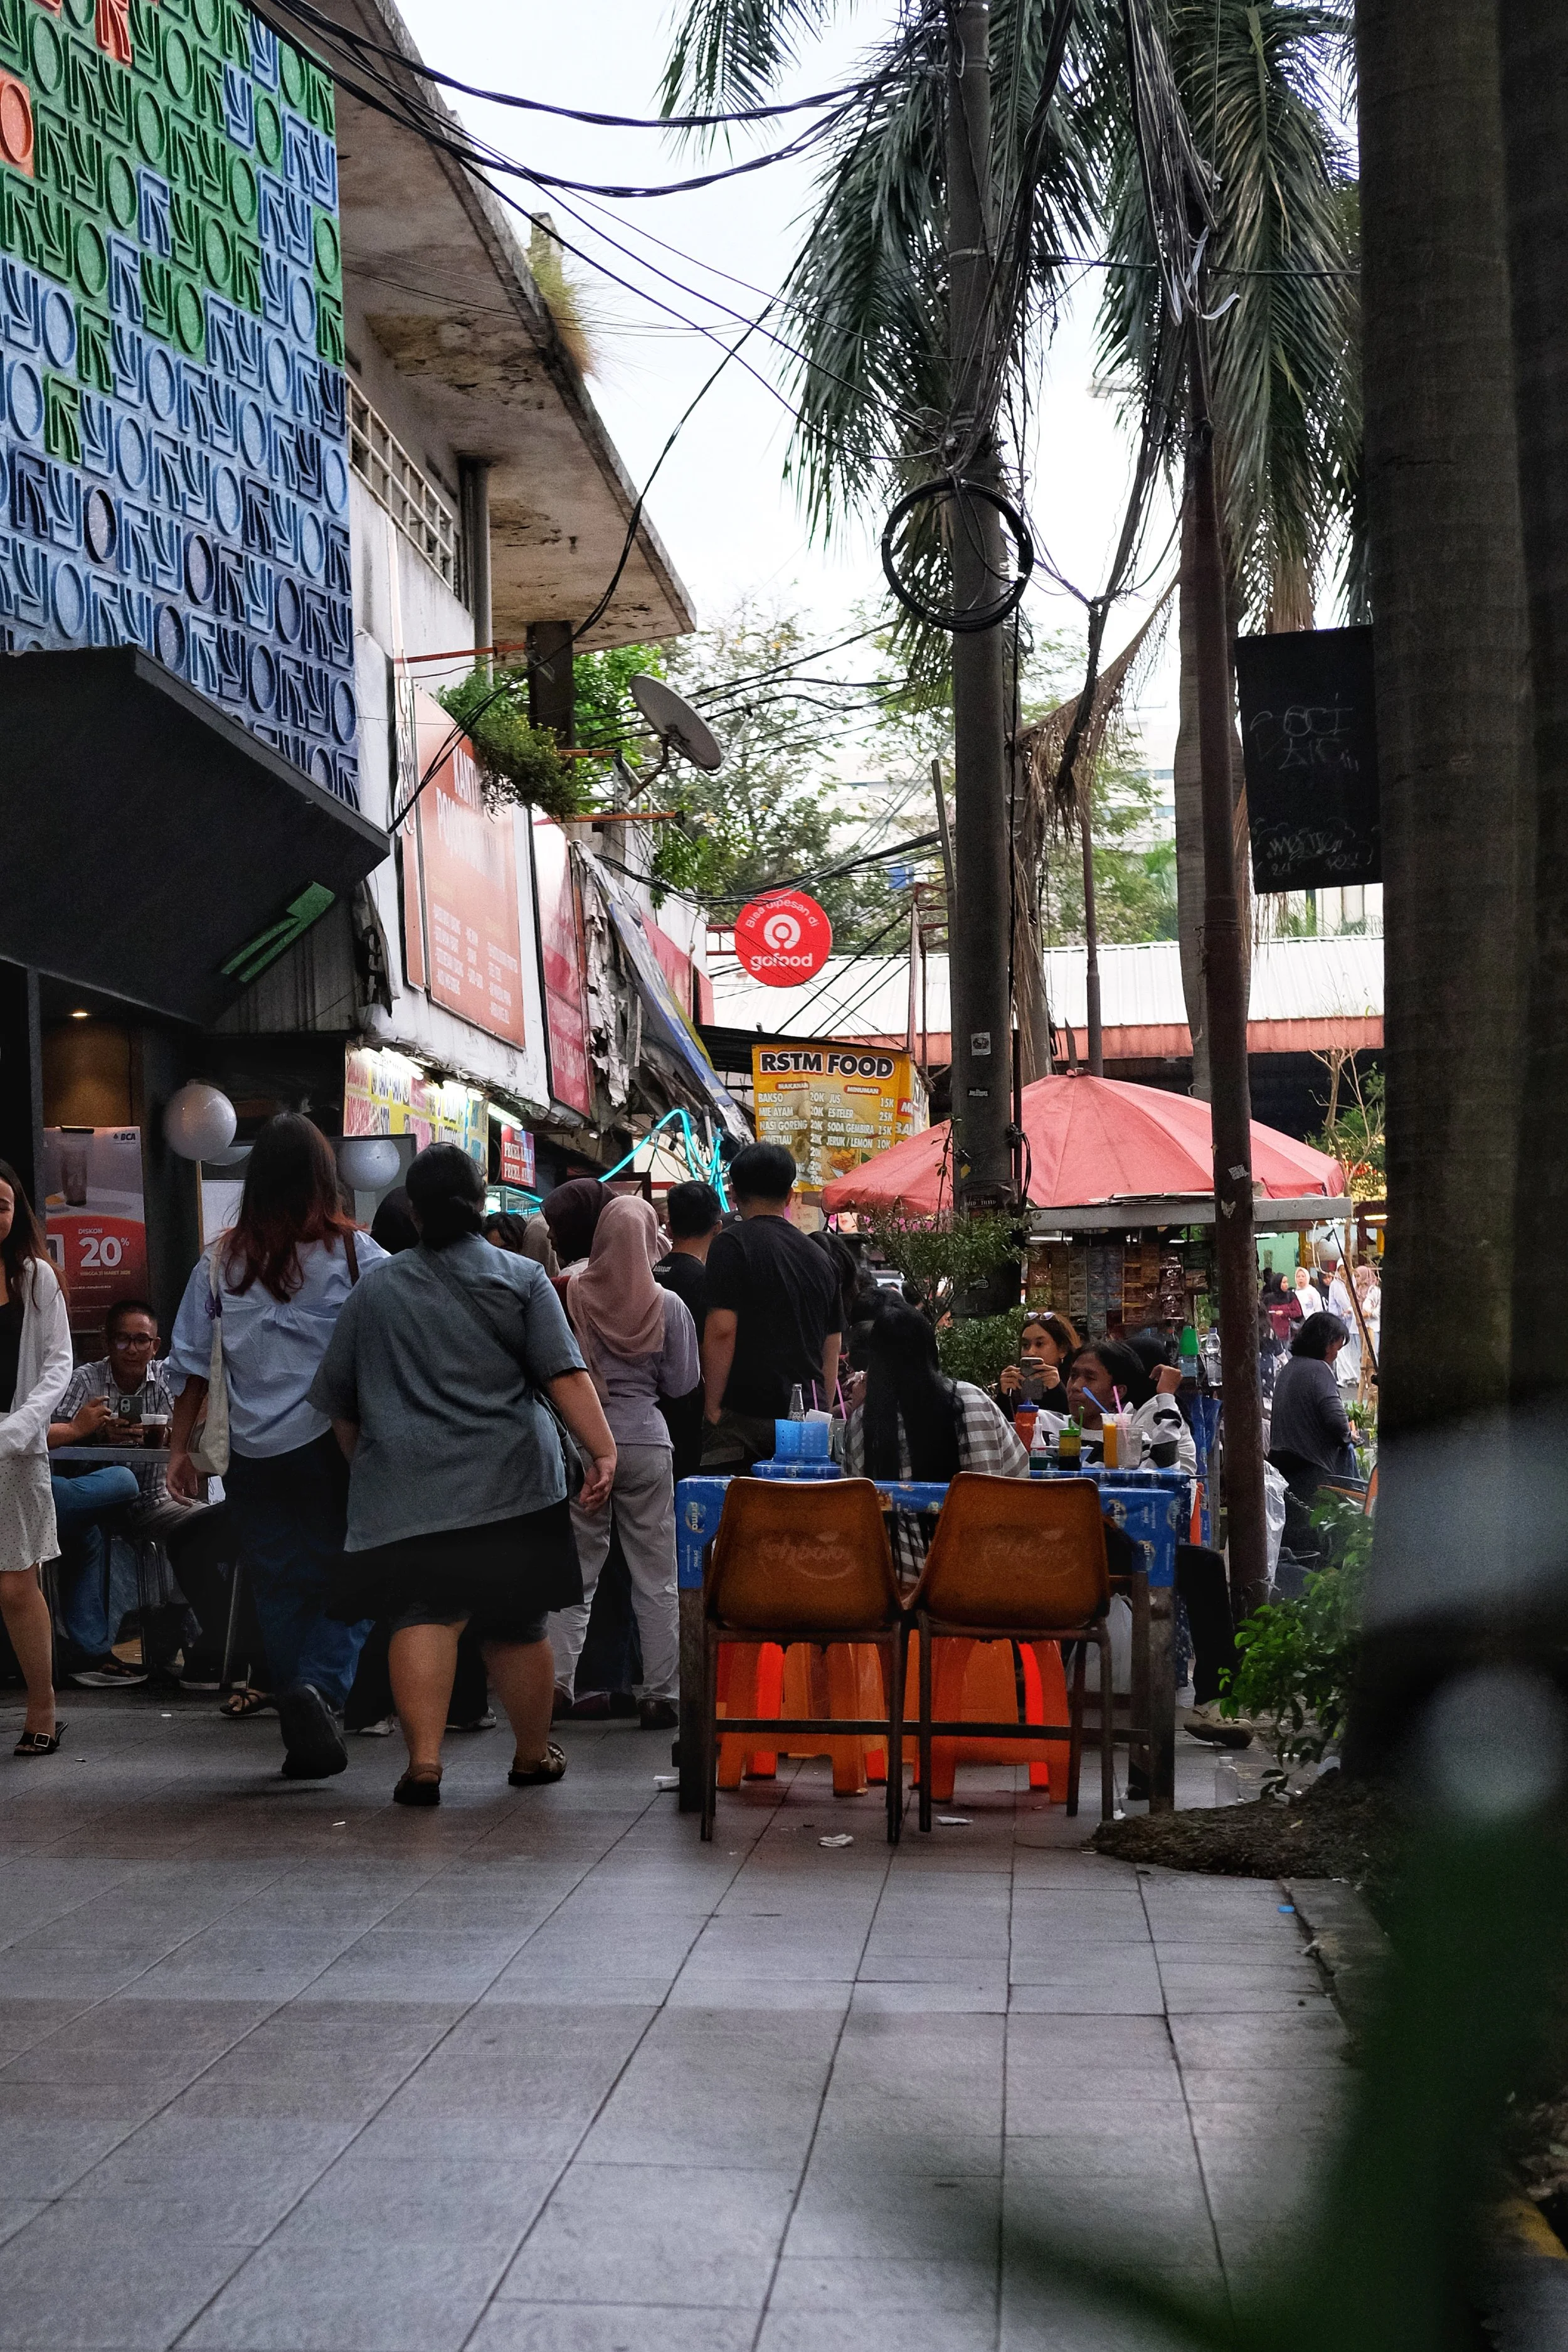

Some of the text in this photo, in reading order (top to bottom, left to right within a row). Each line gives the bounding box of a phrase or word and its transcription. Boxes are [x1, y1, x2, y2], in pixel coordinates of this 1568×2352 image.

[745, 907, 766, 929] Bisa
[808, 917, 820, 927] di
[750, 952, 813, 971] gofood
[760, 1053, 893, 1078] RSTM FOOD
[847, 1086, 879, 1094] MINUMAN
[758, 1092, 825, 1103] BAKSO 20K
[829, 1094, 894, 1108] JUS 15K
[758, 1105, 824, 1117] MIE AYAM 20K
[879, 1111, 893, 1122] 25K
[759, 1120, 776, 1131] NASI
[778, 1120, 808, 1131] GORENG
[827, 1122, 892, 1136] SODA GEMBIRA 15K
[826, 1136, 845, 1147] JERUK
[850, 1137, 873, 1149] LEMON
[877, 1139, 891, 1149] 10K
[504, 1141, 521, 1161] PECEL
[504, 1162, 521, 1181] PECEL
[690, 1501, 699, 1531] prima
